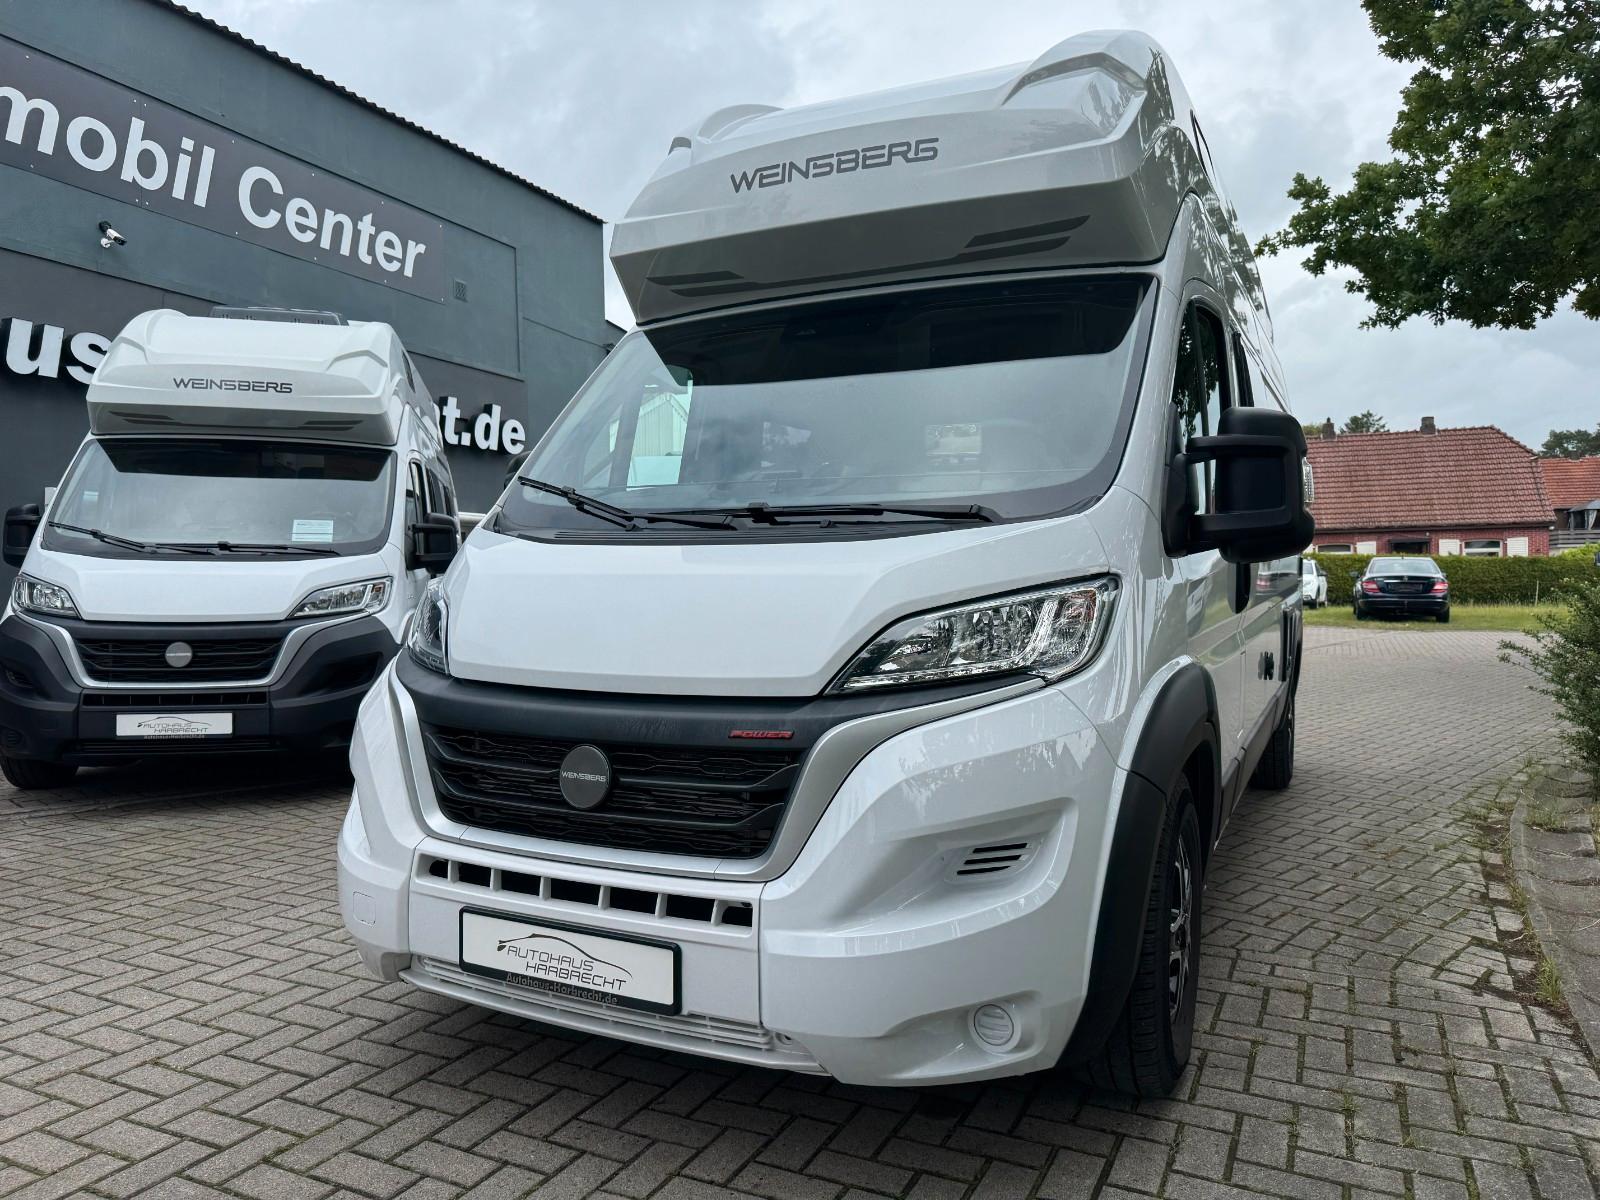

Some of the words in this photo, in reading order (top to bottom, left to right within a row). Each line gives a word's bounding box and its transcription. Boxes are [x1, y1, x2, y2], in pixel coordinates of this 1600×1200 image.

[730, 137, 939, 194] WEINSBERG
[0, 86, 215, 208] mobil
[238, 166, 426, 278] Center
[173, 377, 293, 394] WEINSBERG
[433, 396, 526, 455] t.de
[561, 770, 606, 782] WEINSBERG
[507, 945, 594, 972] AUTOHAUS
[525, 961, 626, 991] HARBRECHT
